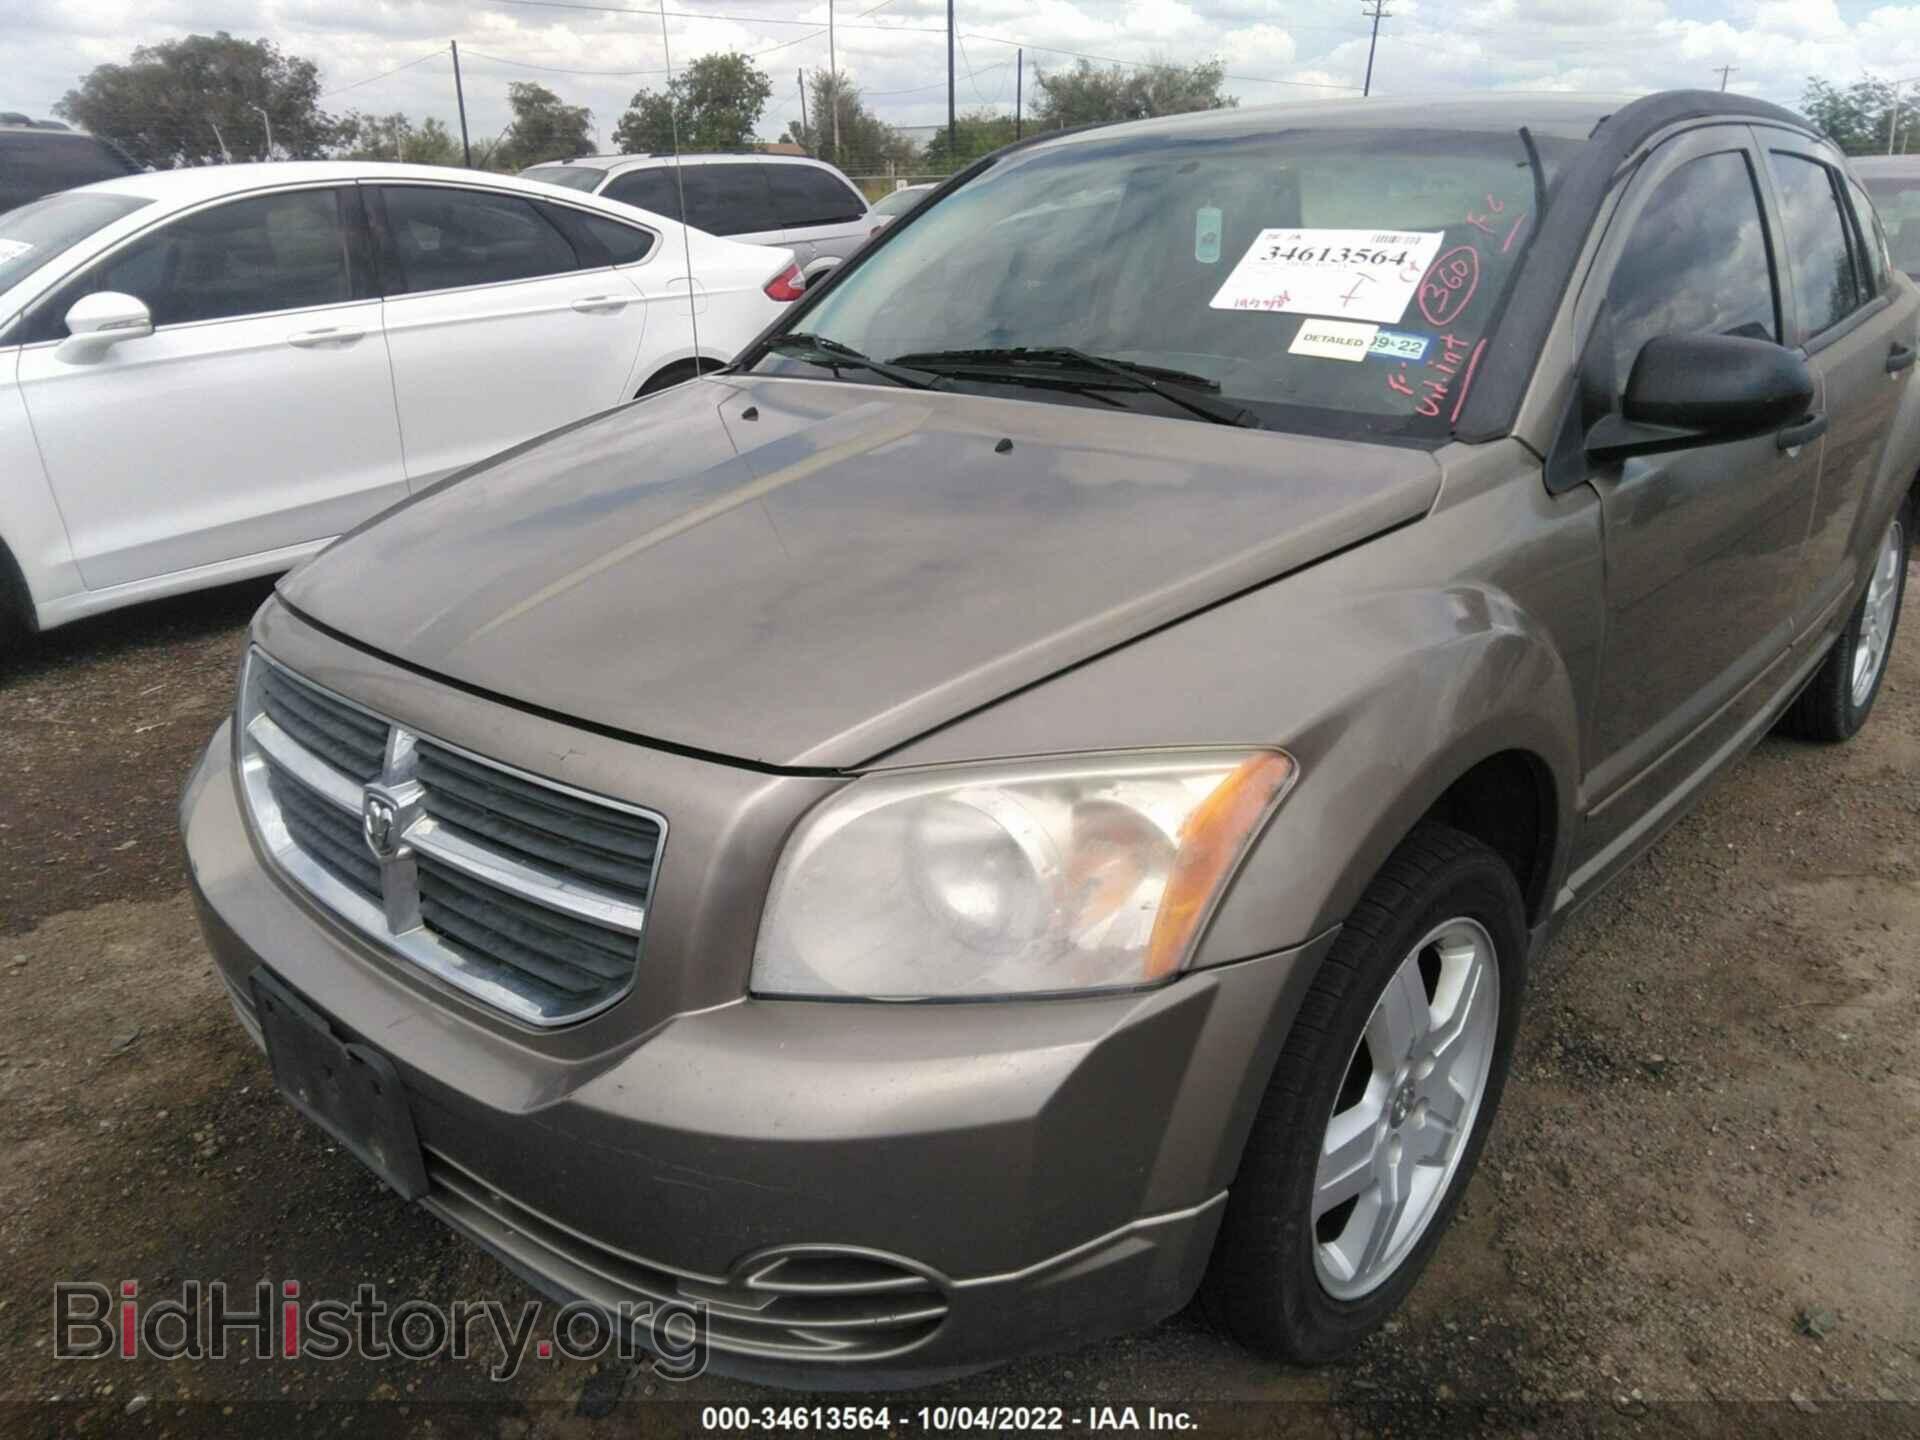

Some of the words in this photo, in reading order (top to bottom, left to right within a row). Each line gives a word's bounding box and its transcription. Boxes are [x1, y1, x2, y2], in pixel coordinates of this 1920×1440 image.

[1260, 246, 1408, 266] 34613564
[1421, 259, 1469, 314] 360
[1303, 333, 1364, 347] DETAILED
